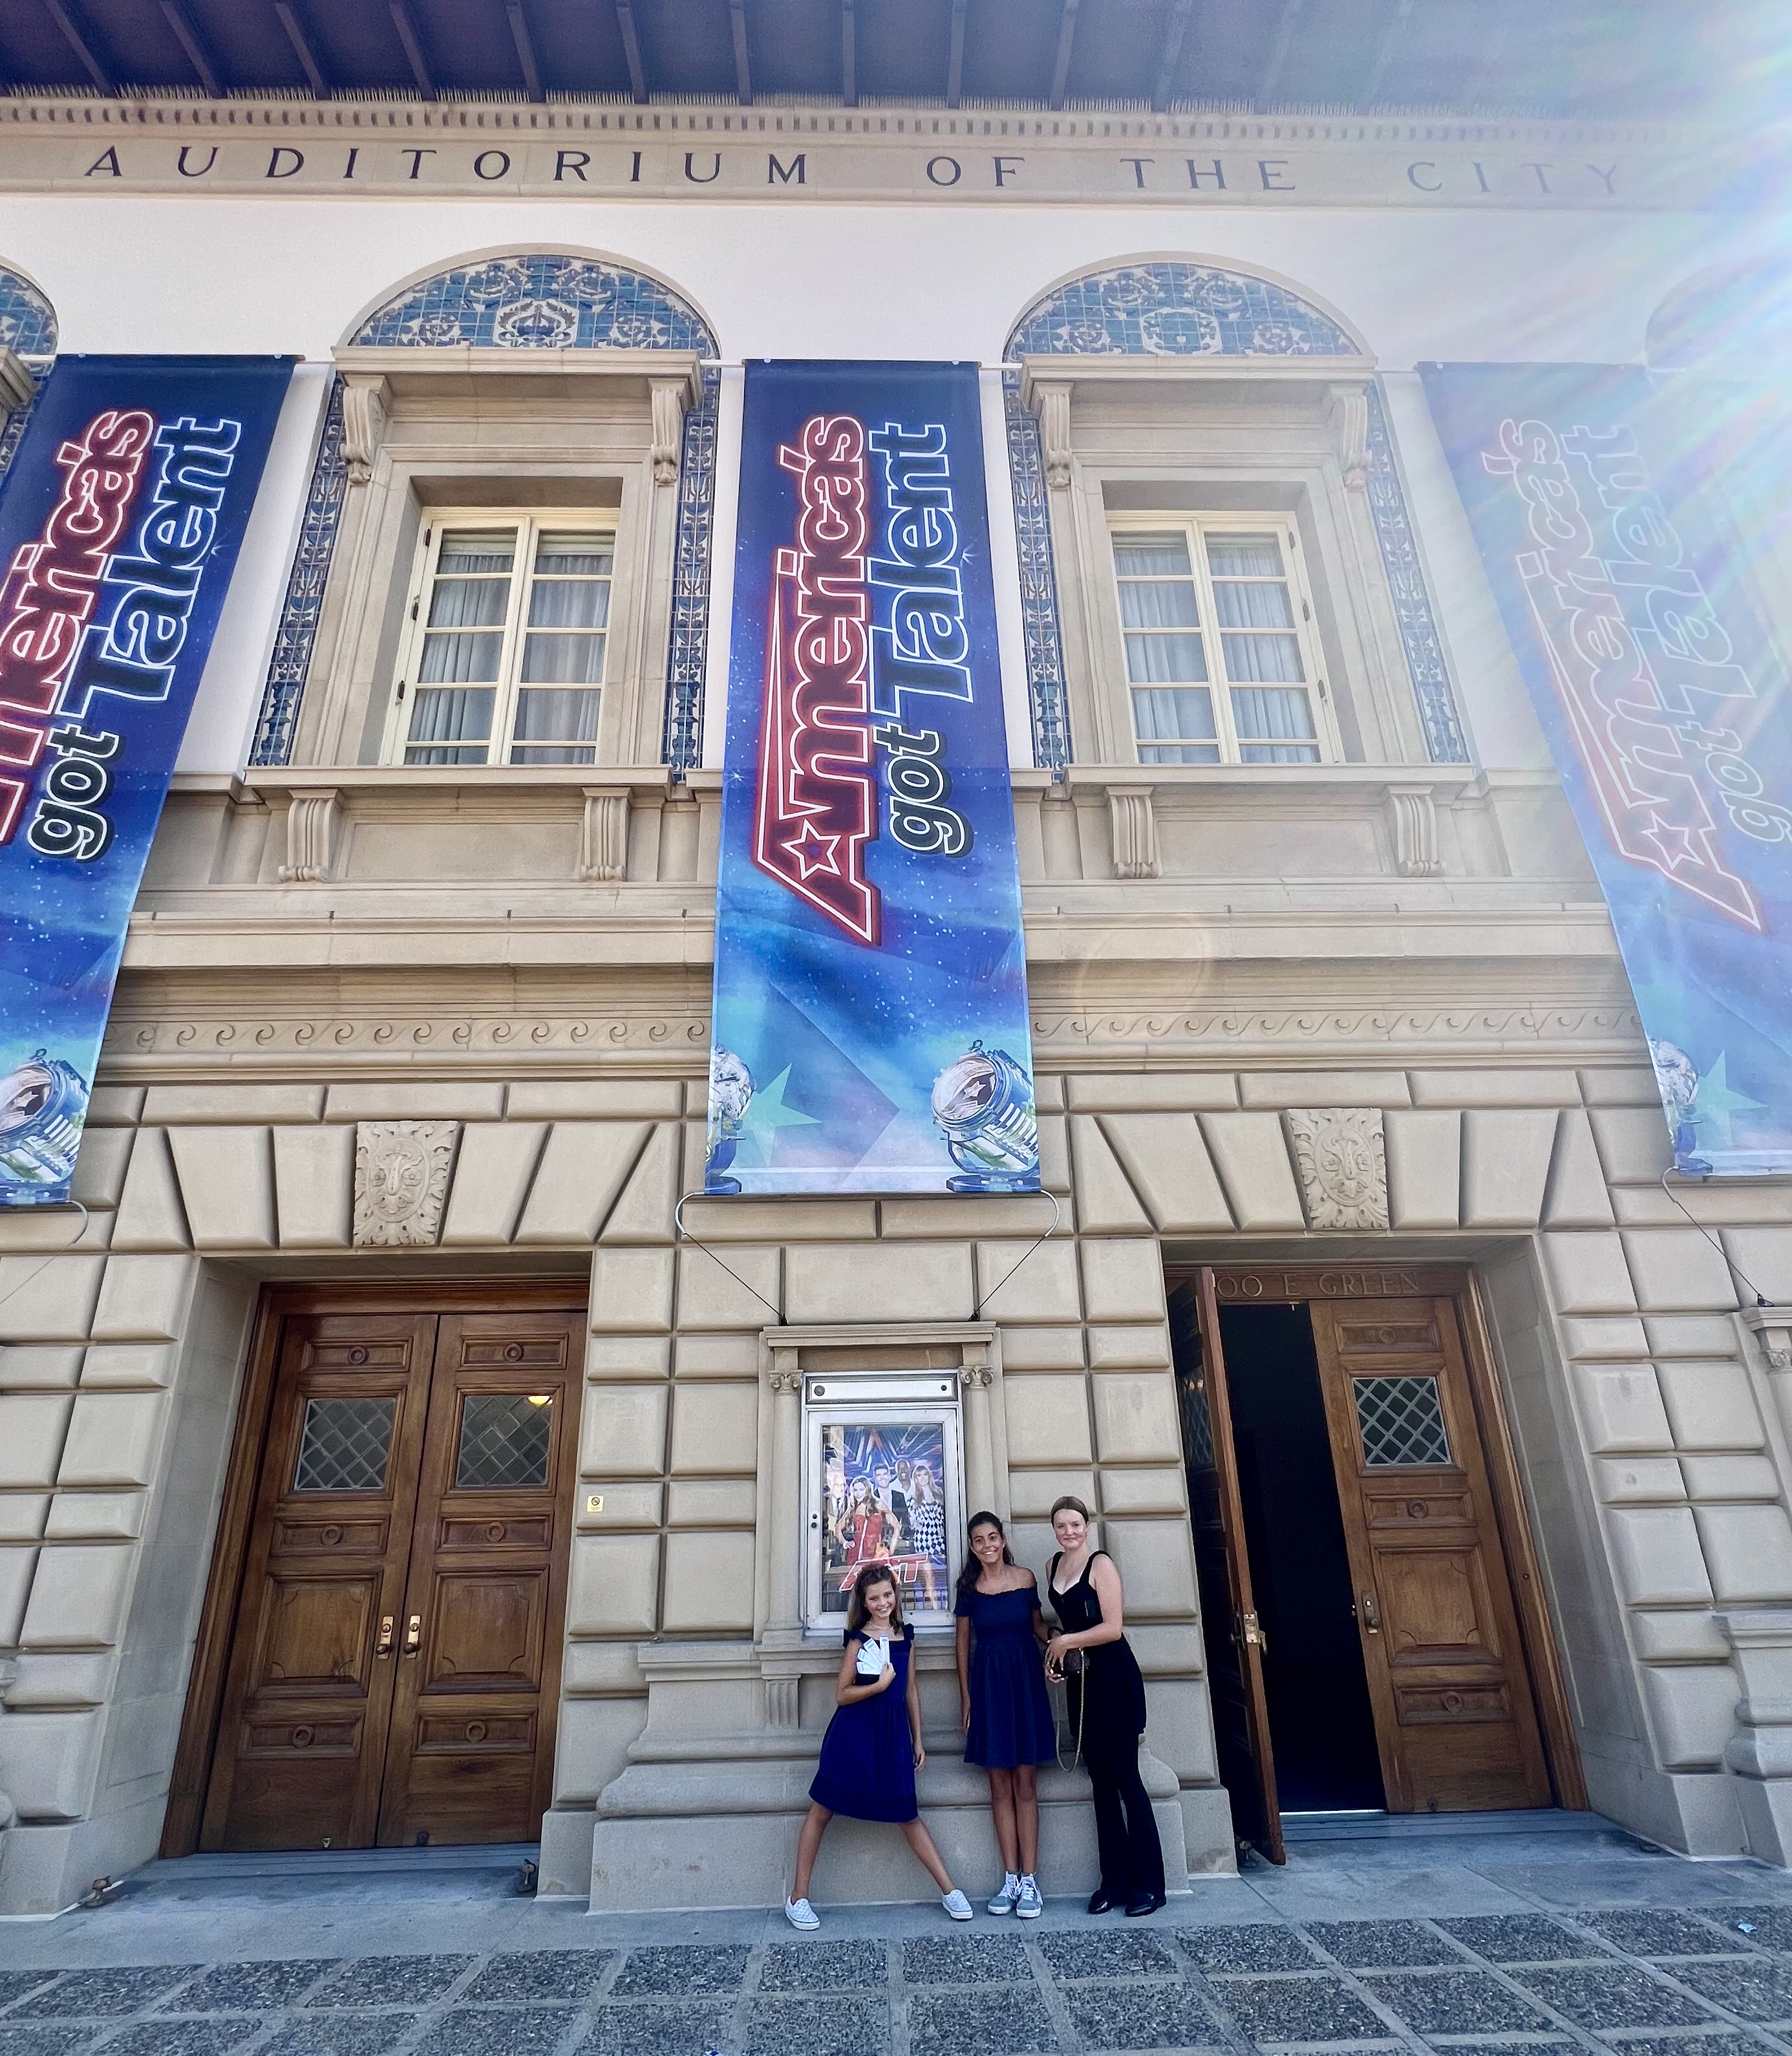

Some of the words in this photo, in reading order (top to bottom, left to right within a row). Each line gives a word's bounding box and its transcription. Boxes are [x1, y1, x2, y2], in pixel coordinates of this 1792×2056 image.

[85, 145, 807, 186] AUDITORIUM
[927, 155, 1025, 187] OF
[1119, 158, 1297, 191] THE
[1406, 161, 1619, 195] CITY
[0, 411, 154, 841] erica's
[56, 416, 242, 718] Talent
[757, 416, 873, 943] America's
[868, 421, 974, 718] Talent
[1481, 418, 1762, 932] America's
[1559, 423, 1758, 714] Talent
[27, 723, 120, 862] got
[873, 722, 966, 856] got
[1676, 720, 1792, 844] got
[1283, 1274, 1301, 1296] E
[1318, 1271, 1421, 1296] GREEN
